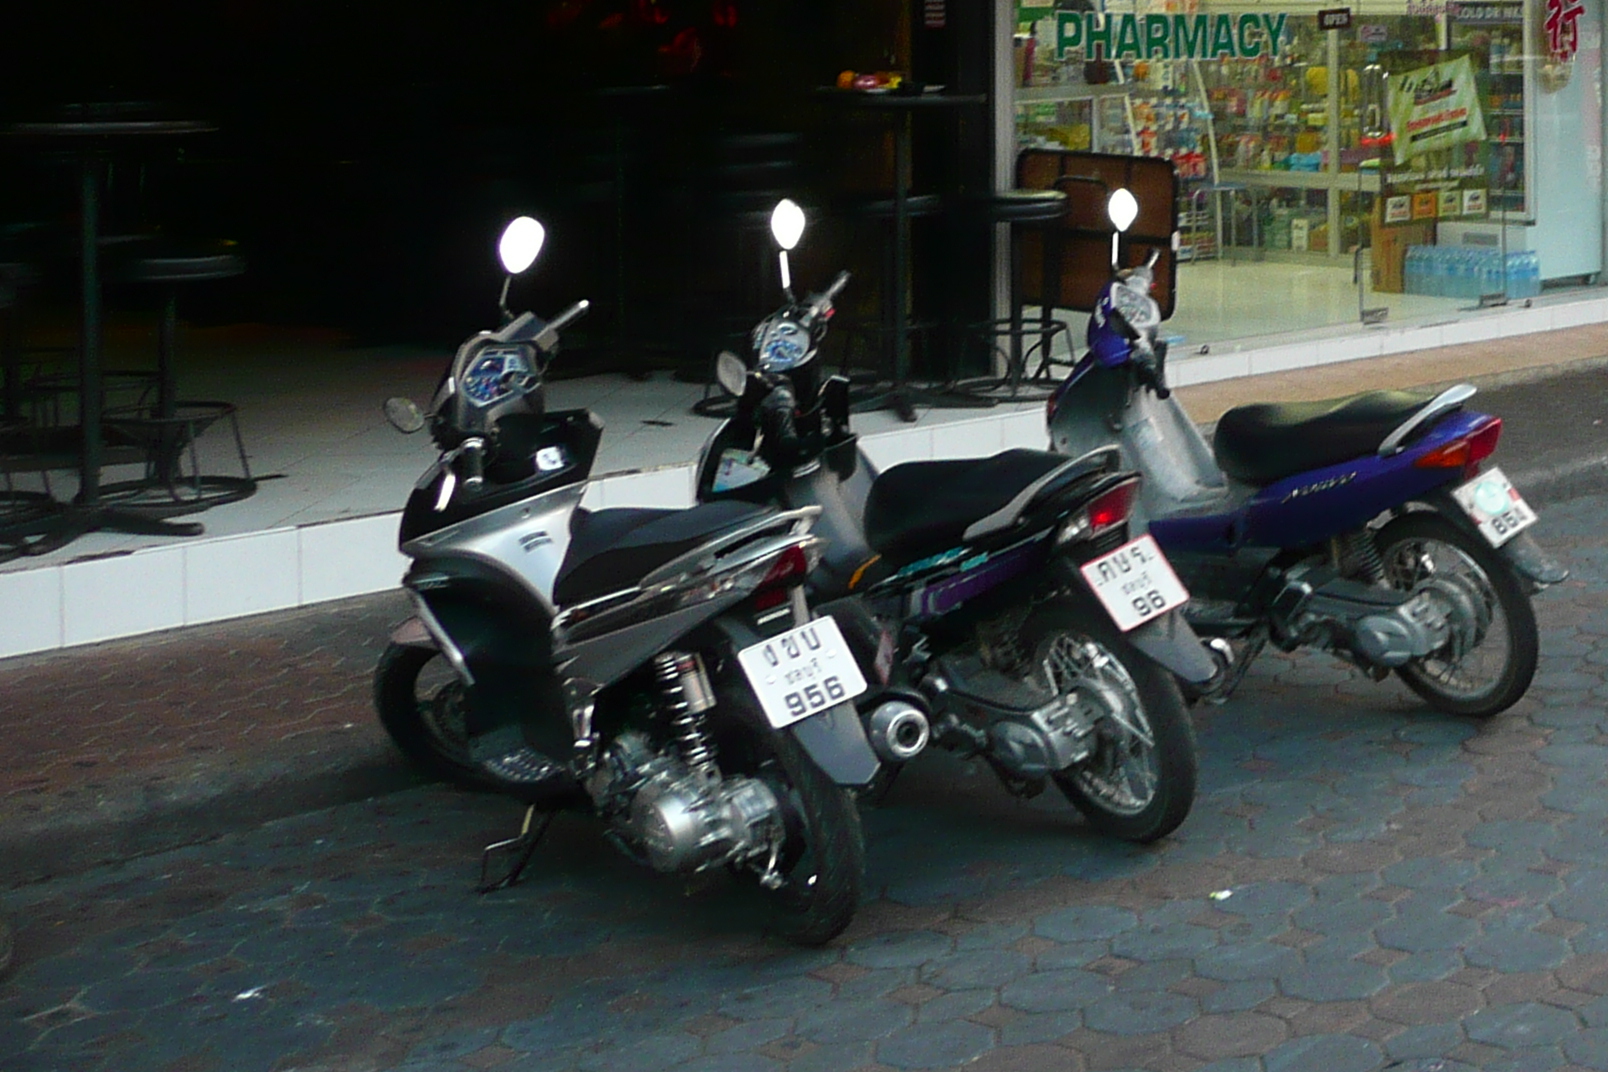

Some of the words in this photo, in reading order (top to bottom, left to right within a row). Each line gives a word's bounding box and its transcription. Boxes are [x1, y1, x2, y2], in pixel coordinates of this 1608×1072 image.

[1055, 9, 1288, 62] PHARMACY
[1131, 588, 1167, 617] 96
[783, 675, 846, 717] 956
